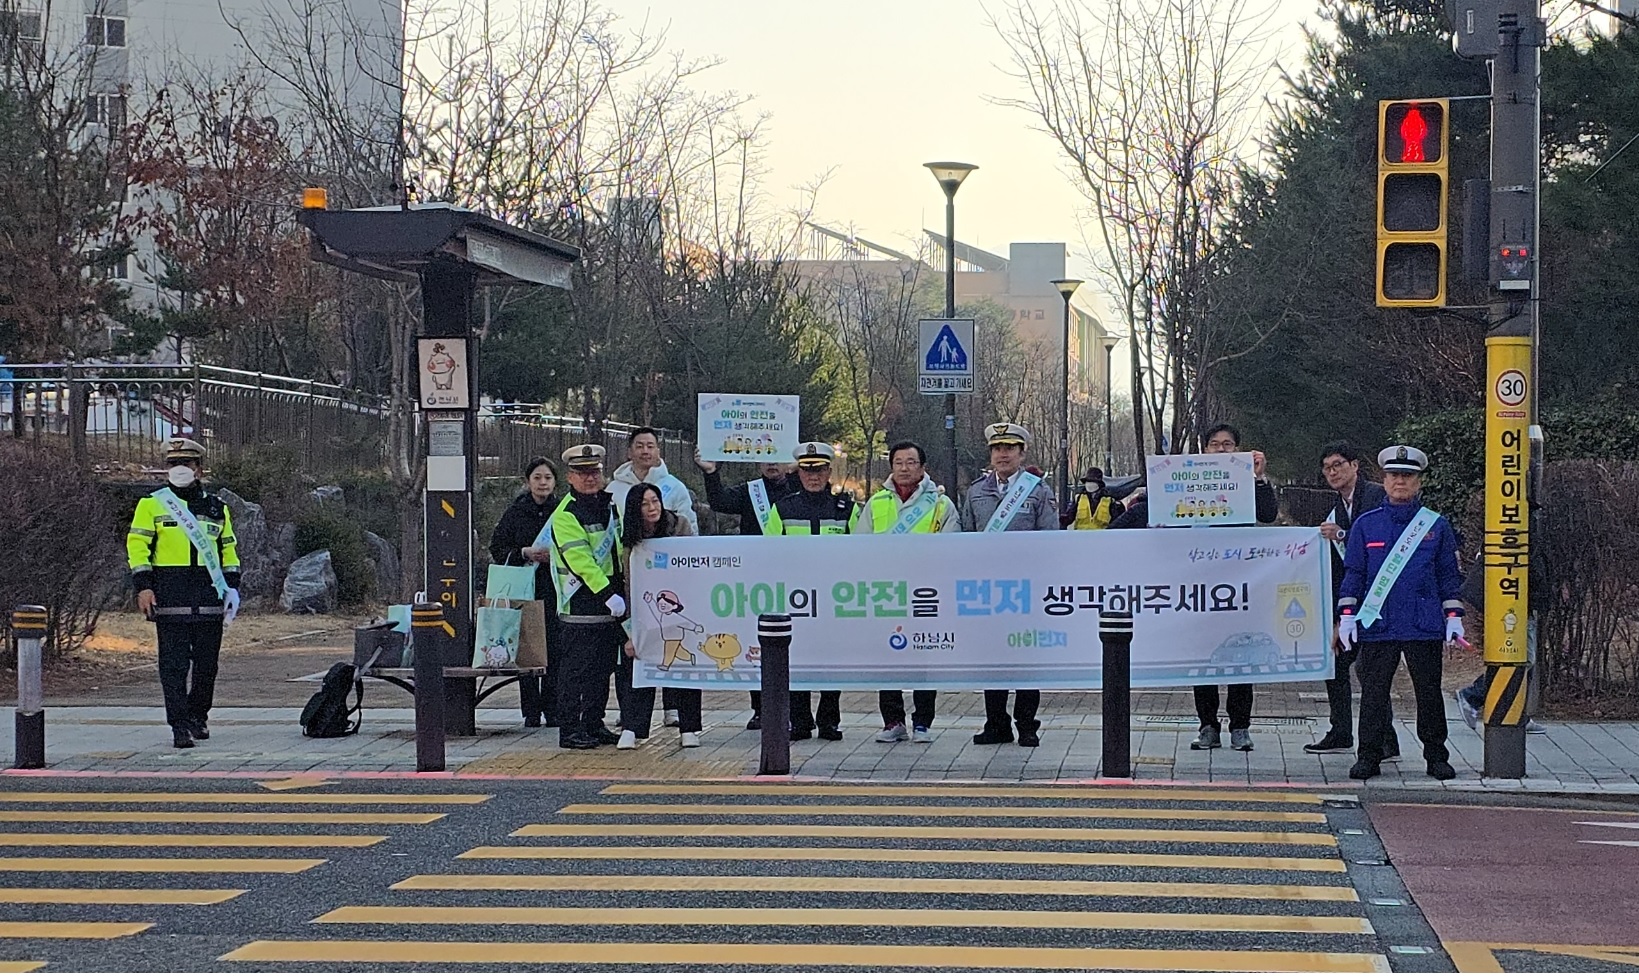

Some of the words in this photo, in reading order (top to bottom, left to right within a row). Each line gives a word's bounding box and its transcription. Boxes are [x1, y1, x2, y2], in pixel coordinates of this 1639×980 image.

[1500, 379, 1524, 396] 30
[721, 409, 748, 420] 아이의
[750, 409, 776, 420] 안전을
[714, 420, 732, 430] 먼저
[734, 422, 783, 431] 생각해주세요!
[1171, 471, 1200, 481] 아이의
[1202, 470, 1230, 480] 안전을
[1164, 483, 1184, 493] 먼저
[1186, 482, 1239, 493] 생각해주세요!
[1499, 429, 1521, 600] 어린이보호구역
[1222, 547, 1242, 560] 도시
[671, 555, 710, 568] 아이먼저
[712, 555, 742, 568] 캠페인
[710, 581, 818, 618] 아이의
[831, 581, 940, 618] 안전을
[955, 579, 1031, 616] 먼저
[1043, 582, 1249, 616] 생각해주세요!
[1290, 623, 1302, 634] 30
[912, 632, 955, 643] 하남시
[1007, 628, 1068, 648] 아이먼저
[941, 643, 955, 651] City
